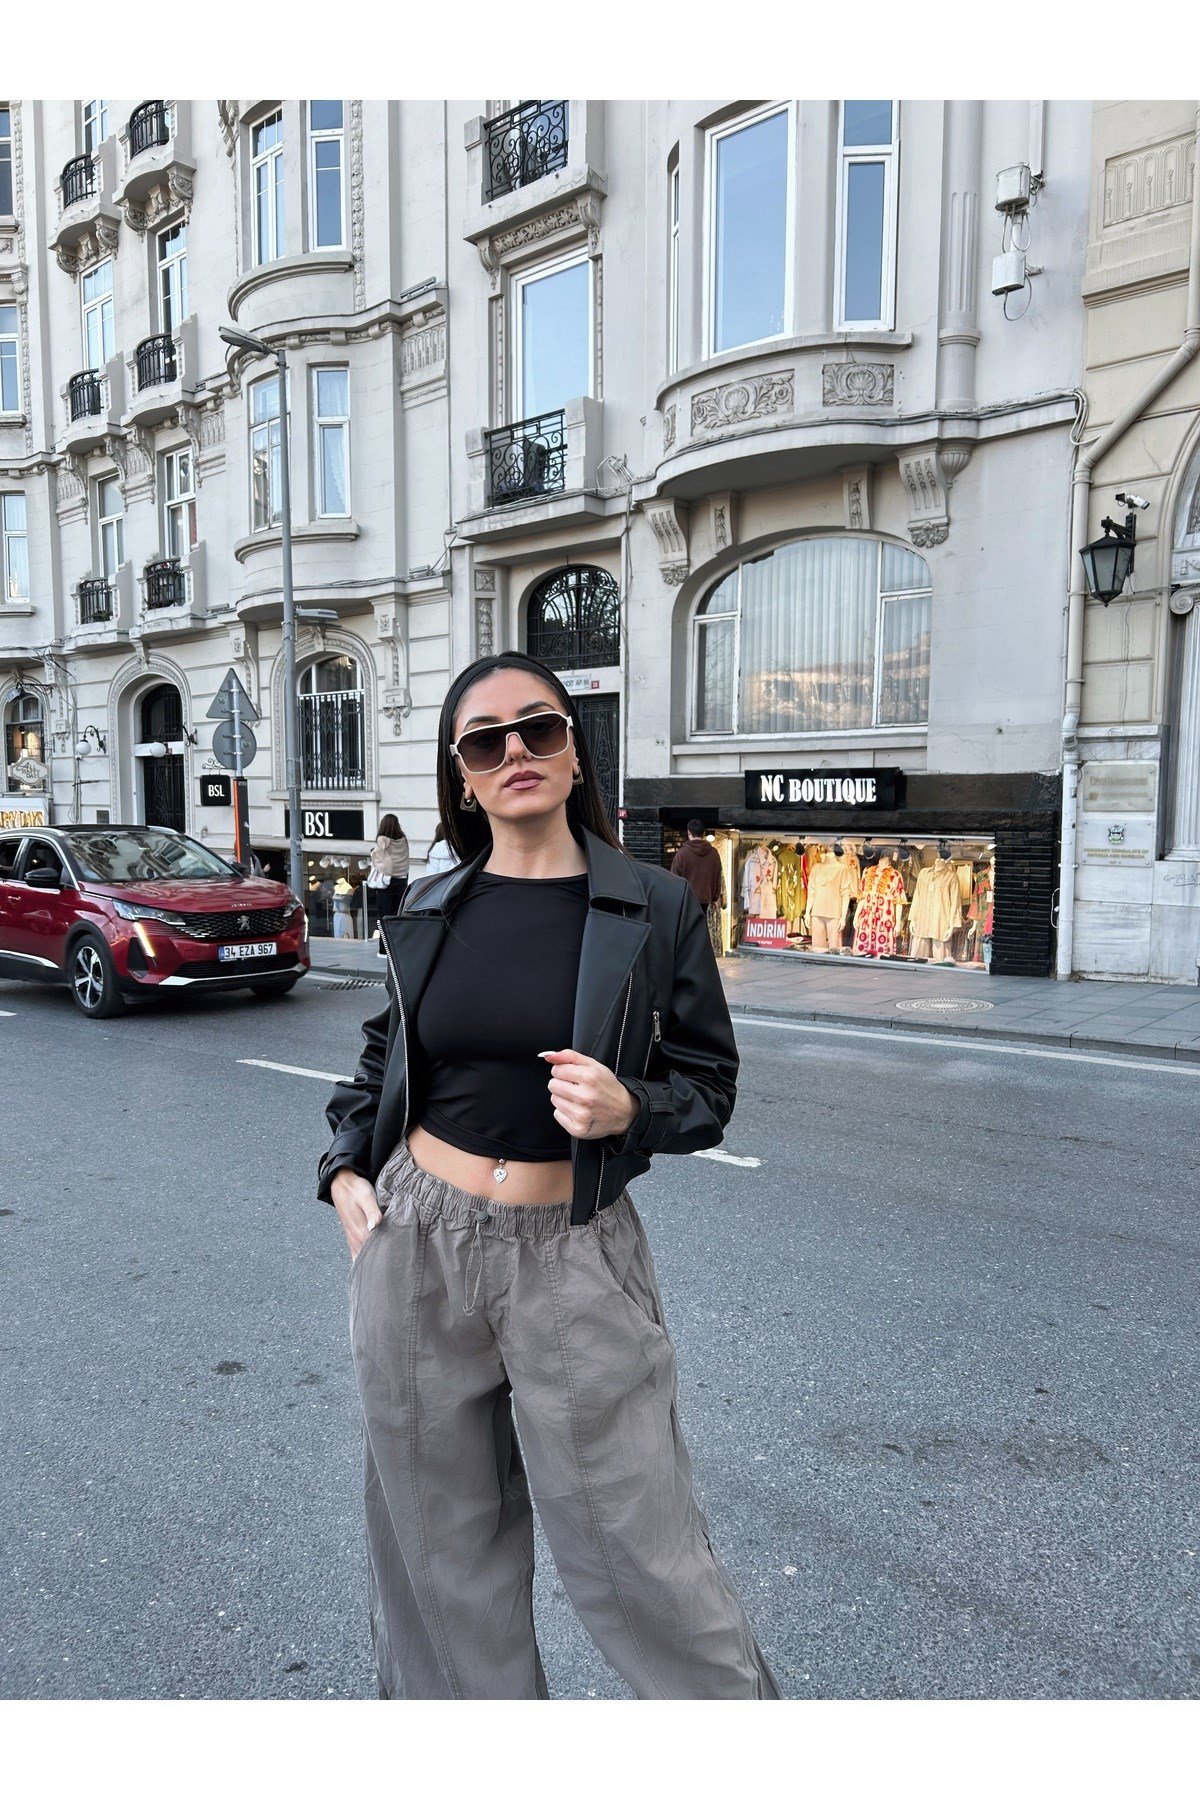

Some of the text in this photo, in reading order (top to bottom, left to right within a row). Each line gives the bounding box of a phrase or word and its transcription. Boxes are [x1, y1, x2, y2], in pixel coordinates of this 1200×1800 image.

[208, 784, 225, 797] BSL
[760, 773, 877, 805] NC BOUTIQUE
[20, 811, 45, 827] DAYS
[305, 811, 334, 837] BSL
[746, 919, 786, 939] İNDİRİM
[225, 943, 273, 958] 34 EZA 967
